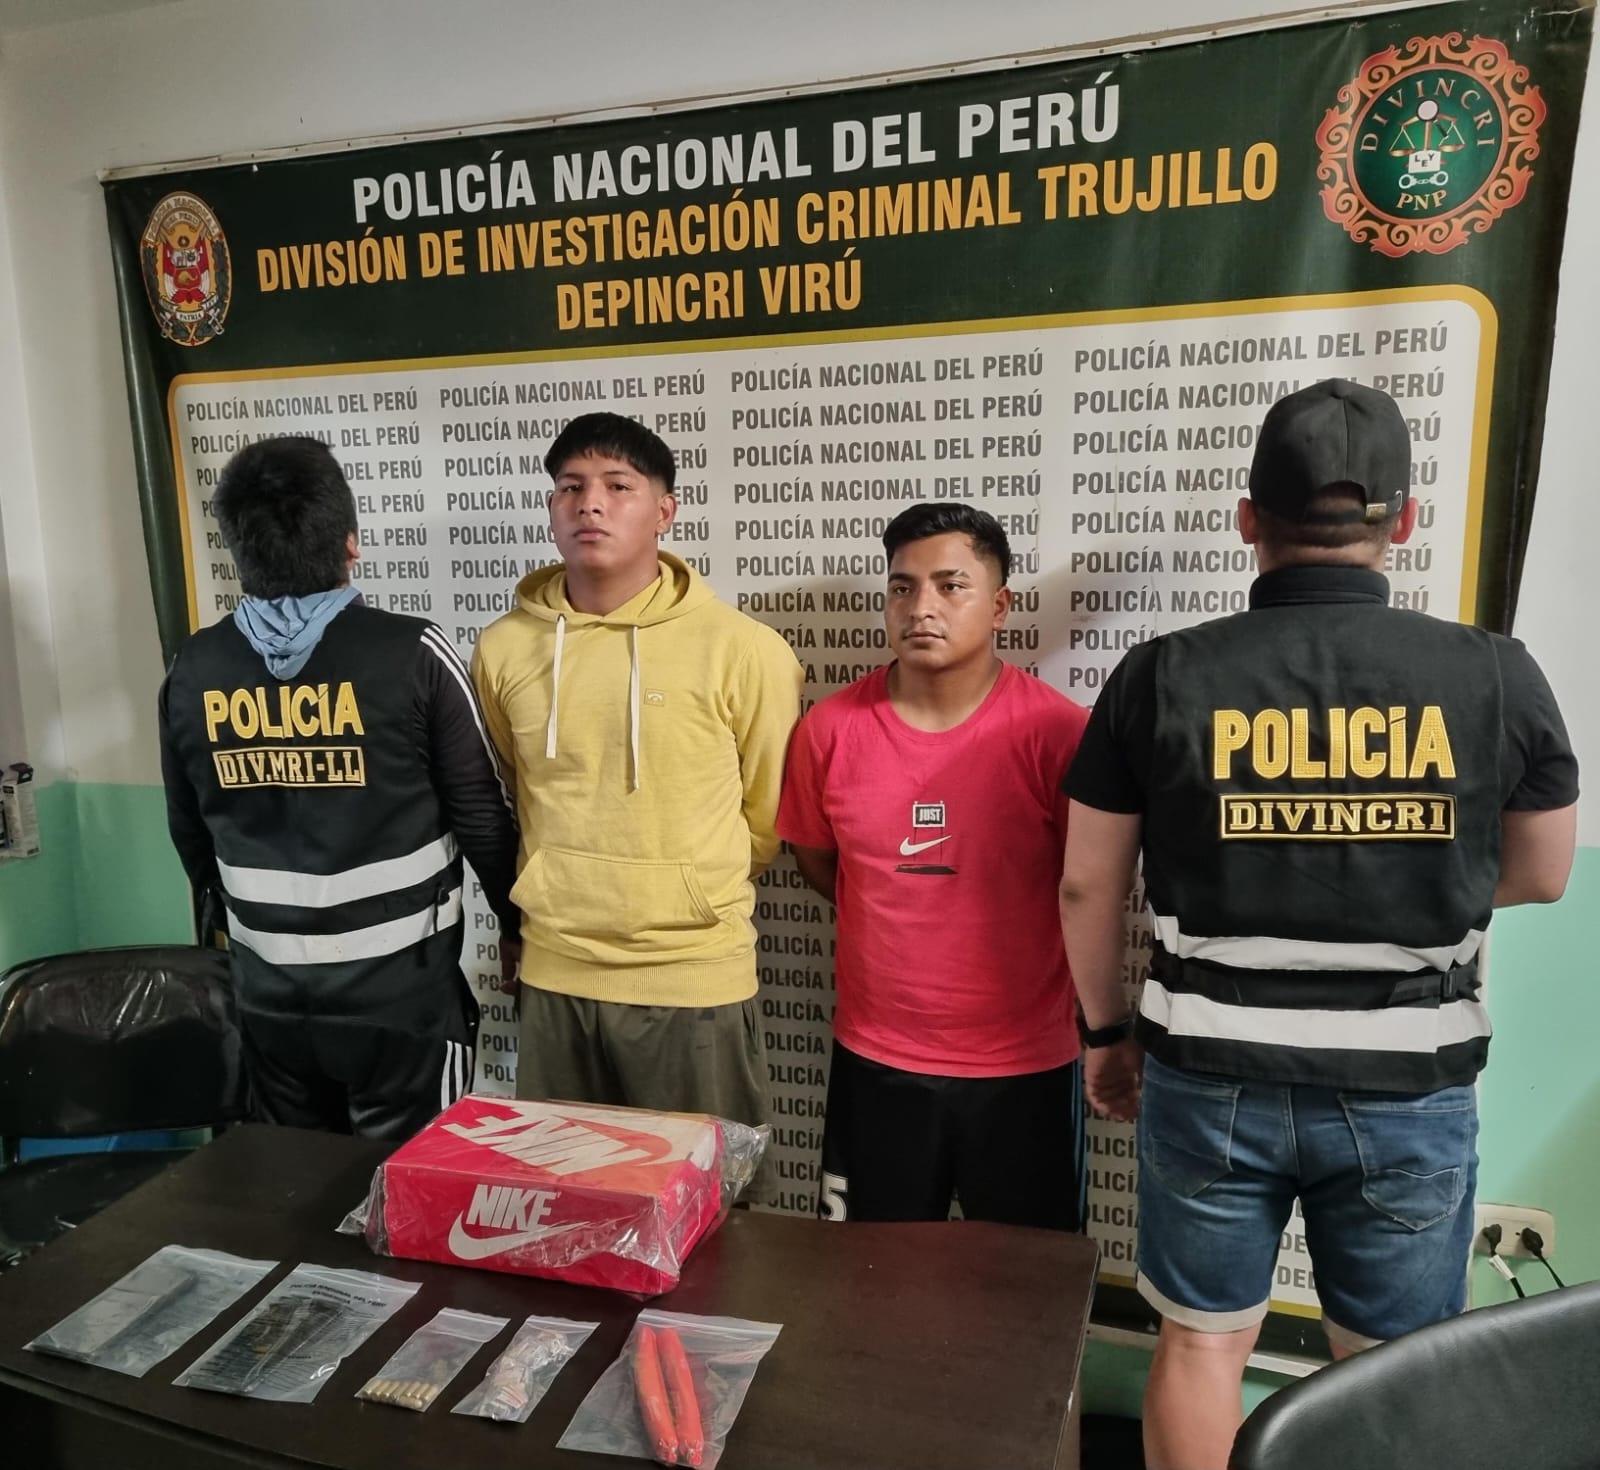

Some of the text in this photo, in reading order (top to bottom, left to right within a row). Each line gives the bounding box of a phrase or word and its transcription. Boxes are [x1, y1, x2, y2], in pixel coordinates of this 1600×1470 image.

[1360, 77, 1495, 152] DIVINCRI
[353, 72, 1121, 225] POLICÍA NACIONAL DEL PERÚ
[1414, 152, 1435, 168] LEY
[1396, 189, 1447, 210] PNP
[257, 142, 1279, 292] DIVISIÓN DE INVESTIGACIÓN CRIMINAL TRUJILLO
[557, 247, 863, 331] DEPINCRI VIRÚ
[1074, 320, 1448, 373] POLICÍA NACIONAL DEL PERÚ
[731, 347, 1043, 393] POLICÍA NACIONAL DEL PERÚ
[440, 368, 705, 408] POLICÍA NACIONAL DEL PERÚ
[1073, 382, 1169, 414] POLICÍA
[1373, 366, 1445, 398] PERÚ
[187, 386, 418, 421] POLICÍA NACIONAL DEL PERÚ
[732, 388, 1043, 430] POLICÍA NACIONAL DEL PERÚ
[191, 430, 251, 454] POLICÍA
[341, 428, 371, 448] DEL
[376, 421, 420, 445] PERÚ
[442, 407, 706, 442] POLICÍA NACI PERÚ
[1072, 411, 1441, 455] POLICÍA NACIO RÚ
[444, 452, 513, 477] POLICÍA
[673, 444, 707, 470] ERÚ
[733, 430, 1042, 467] POLICÍA NACIONAL DEL PERÚ
[343, 456, 422, 481] DEL PERÚ
[1072, 455, 1438, 494] POLICÍA NACIO RÚ
[447, 488, 515, 511] POLICÍA
[676, 480, 708, 505] ERÚ
[734, 469, 1042, 504] POLICÍA NACIONAL DEL PERÚ
[358, 490, 424, 513] EL PERÚ
[449, 521, 517, 545] POLICÍA
[665, 516, 709, 542] ERÚ
[735, 508, 1039, 540] POLICÍA NACIO ERÚ
[1071, 506, 1240, 534] POLICÍA NACI
[360, 523, 427, 547] EL PERÚ
[212, 556, 429, 581] POLI DEL PERÚ
[451, 556, 519, 579] POLICÍA
[687, 552, 710, 577] RÚ
[736, 548, 1039, 576] POLICÍA NACIO RÚ
[1071, 542, 1432, 573] POLICÍA NACIO ERÚ
[215, 590, 432, 612] POLI EL PERÚ
[737, 586, 1039, 613] POLICÍA NACIO RÚ
[1070, 585, 1429, 613] POLICÍA NACIO RÚ
[824, 629, 891, 649] NACIO
[993, 624, 1039, 650] ERÚ
[203, 682, 365, 742] POLICÍA
[1213, 706, 1456, 780] POLICÍA
[219, 752, 362, 783] DIV.MRI-LL
[919, 808, 941, 822] JUST
[1229, 802, 1446, 832] DIVINCRI
[758, 868, 811, 890] OLIC
[757, 901, 823, 924] OLICÍA
[757, 933, 823, 957] OLICÍA
[757, 966, 824, 990] OLICÍA
[480, 1003, 520, 1023] POLI
[762, 1000, 824, 1022] OLICÍA
[482, 1034, 518, 1053] POLI
[765, 1032, 825, 1055] OLICÍA
[768, 1064, 826, 1087] OLICÍA
[772, 1096, 825, 1119] LICÍA
[772, 1128, 822, 1151] LICÍA
[1086, 1136, 1138, 1159] LICÍ
[776, 1160, 821, 1182] LICÍ
[1087, 1169, 1138, 1193] LICÍ
[466, 1184, 553, 1232] NIKE
[768, 1191, 817, 1214] LICÍ
[1087, 1203, 1138, 1228] LICÍ
[1280, 1232, 1306, 1254] DE
